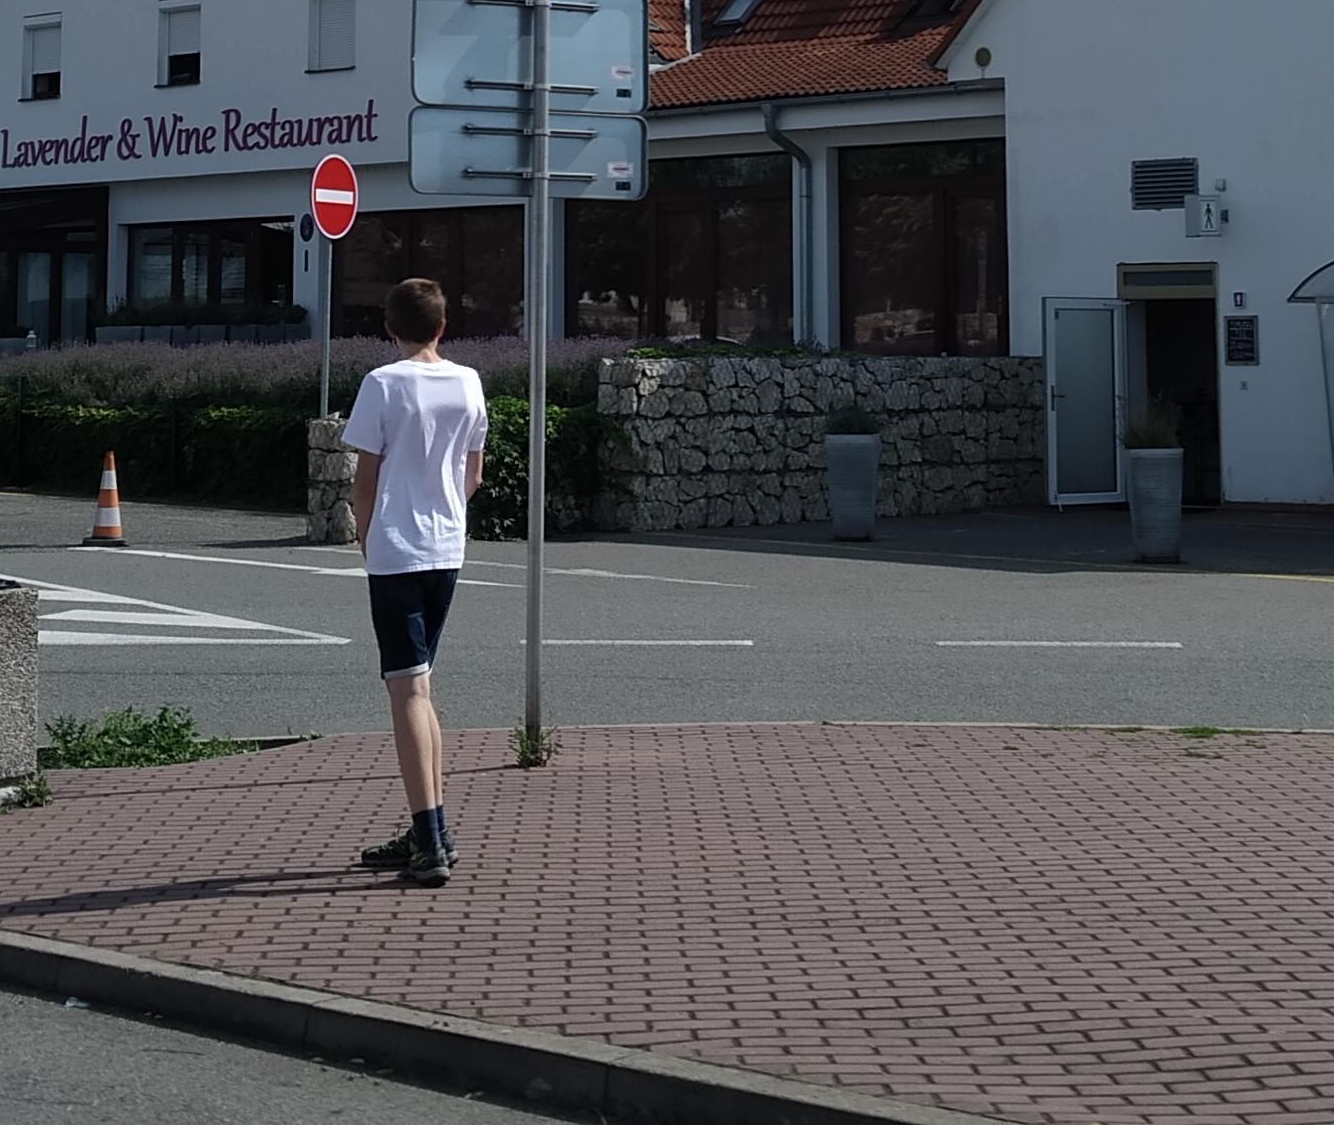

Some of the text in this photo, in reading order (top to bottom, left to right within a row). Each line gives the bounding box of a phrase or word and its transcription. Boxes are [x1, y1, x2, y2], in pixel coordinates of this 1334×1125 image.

[0, 98, 379, 169] Lavender & Wine Restaurant
